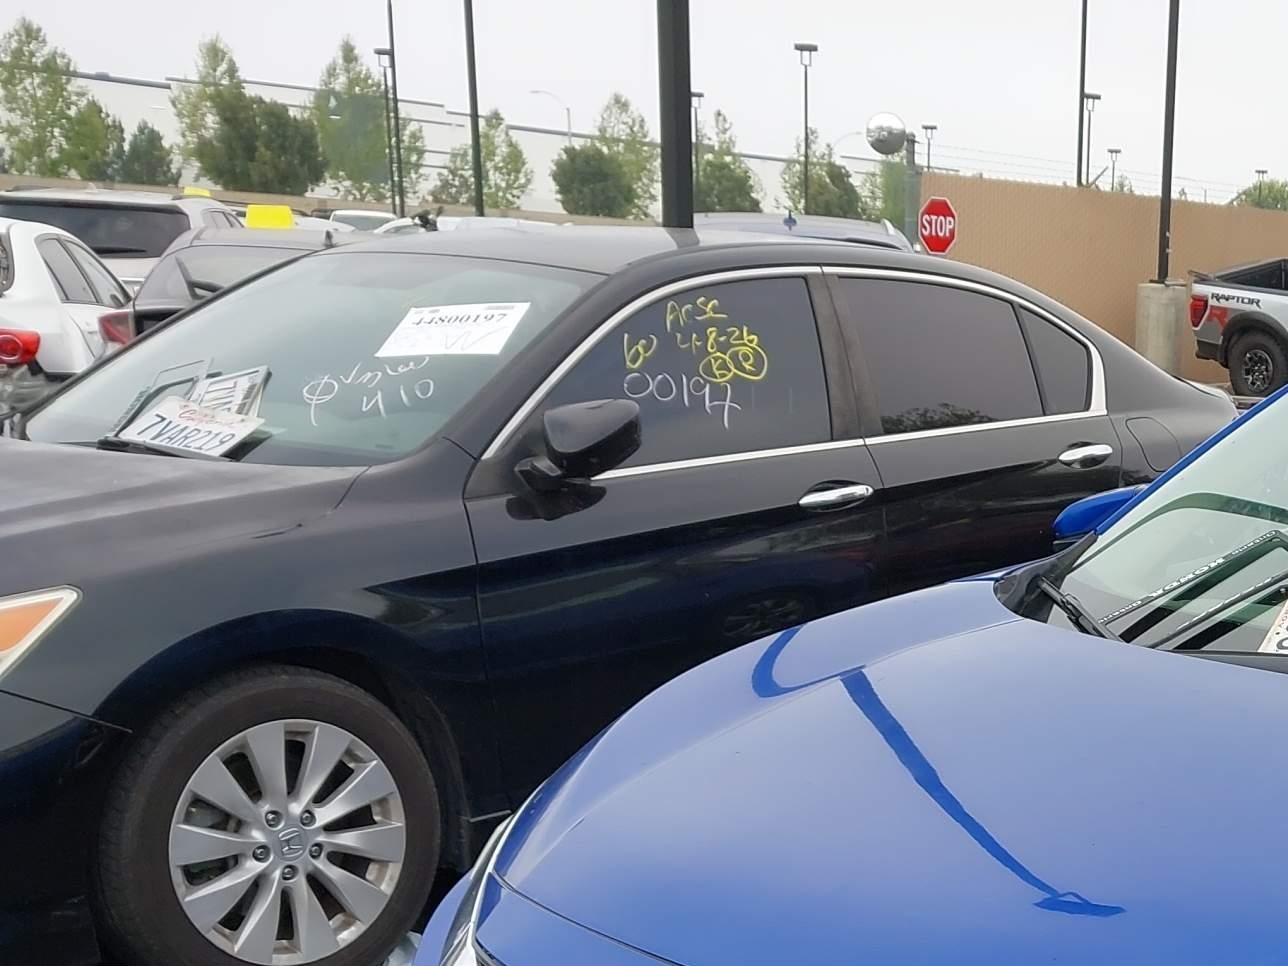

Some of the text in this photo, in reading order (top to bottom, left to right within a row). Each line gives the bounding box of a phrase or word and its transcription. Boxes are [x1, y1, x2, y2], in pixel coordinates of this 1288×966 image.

[921, 213, 955, 237] STOP
[1210, 291, 1262, 309] RAPTOR
[412, 312, 508, 326] 44800197
[623, 372, 742, 430] 00197
[137, 413, 236, 451] 7VAR219
[1147, 556, 1225, 599] HONDA
